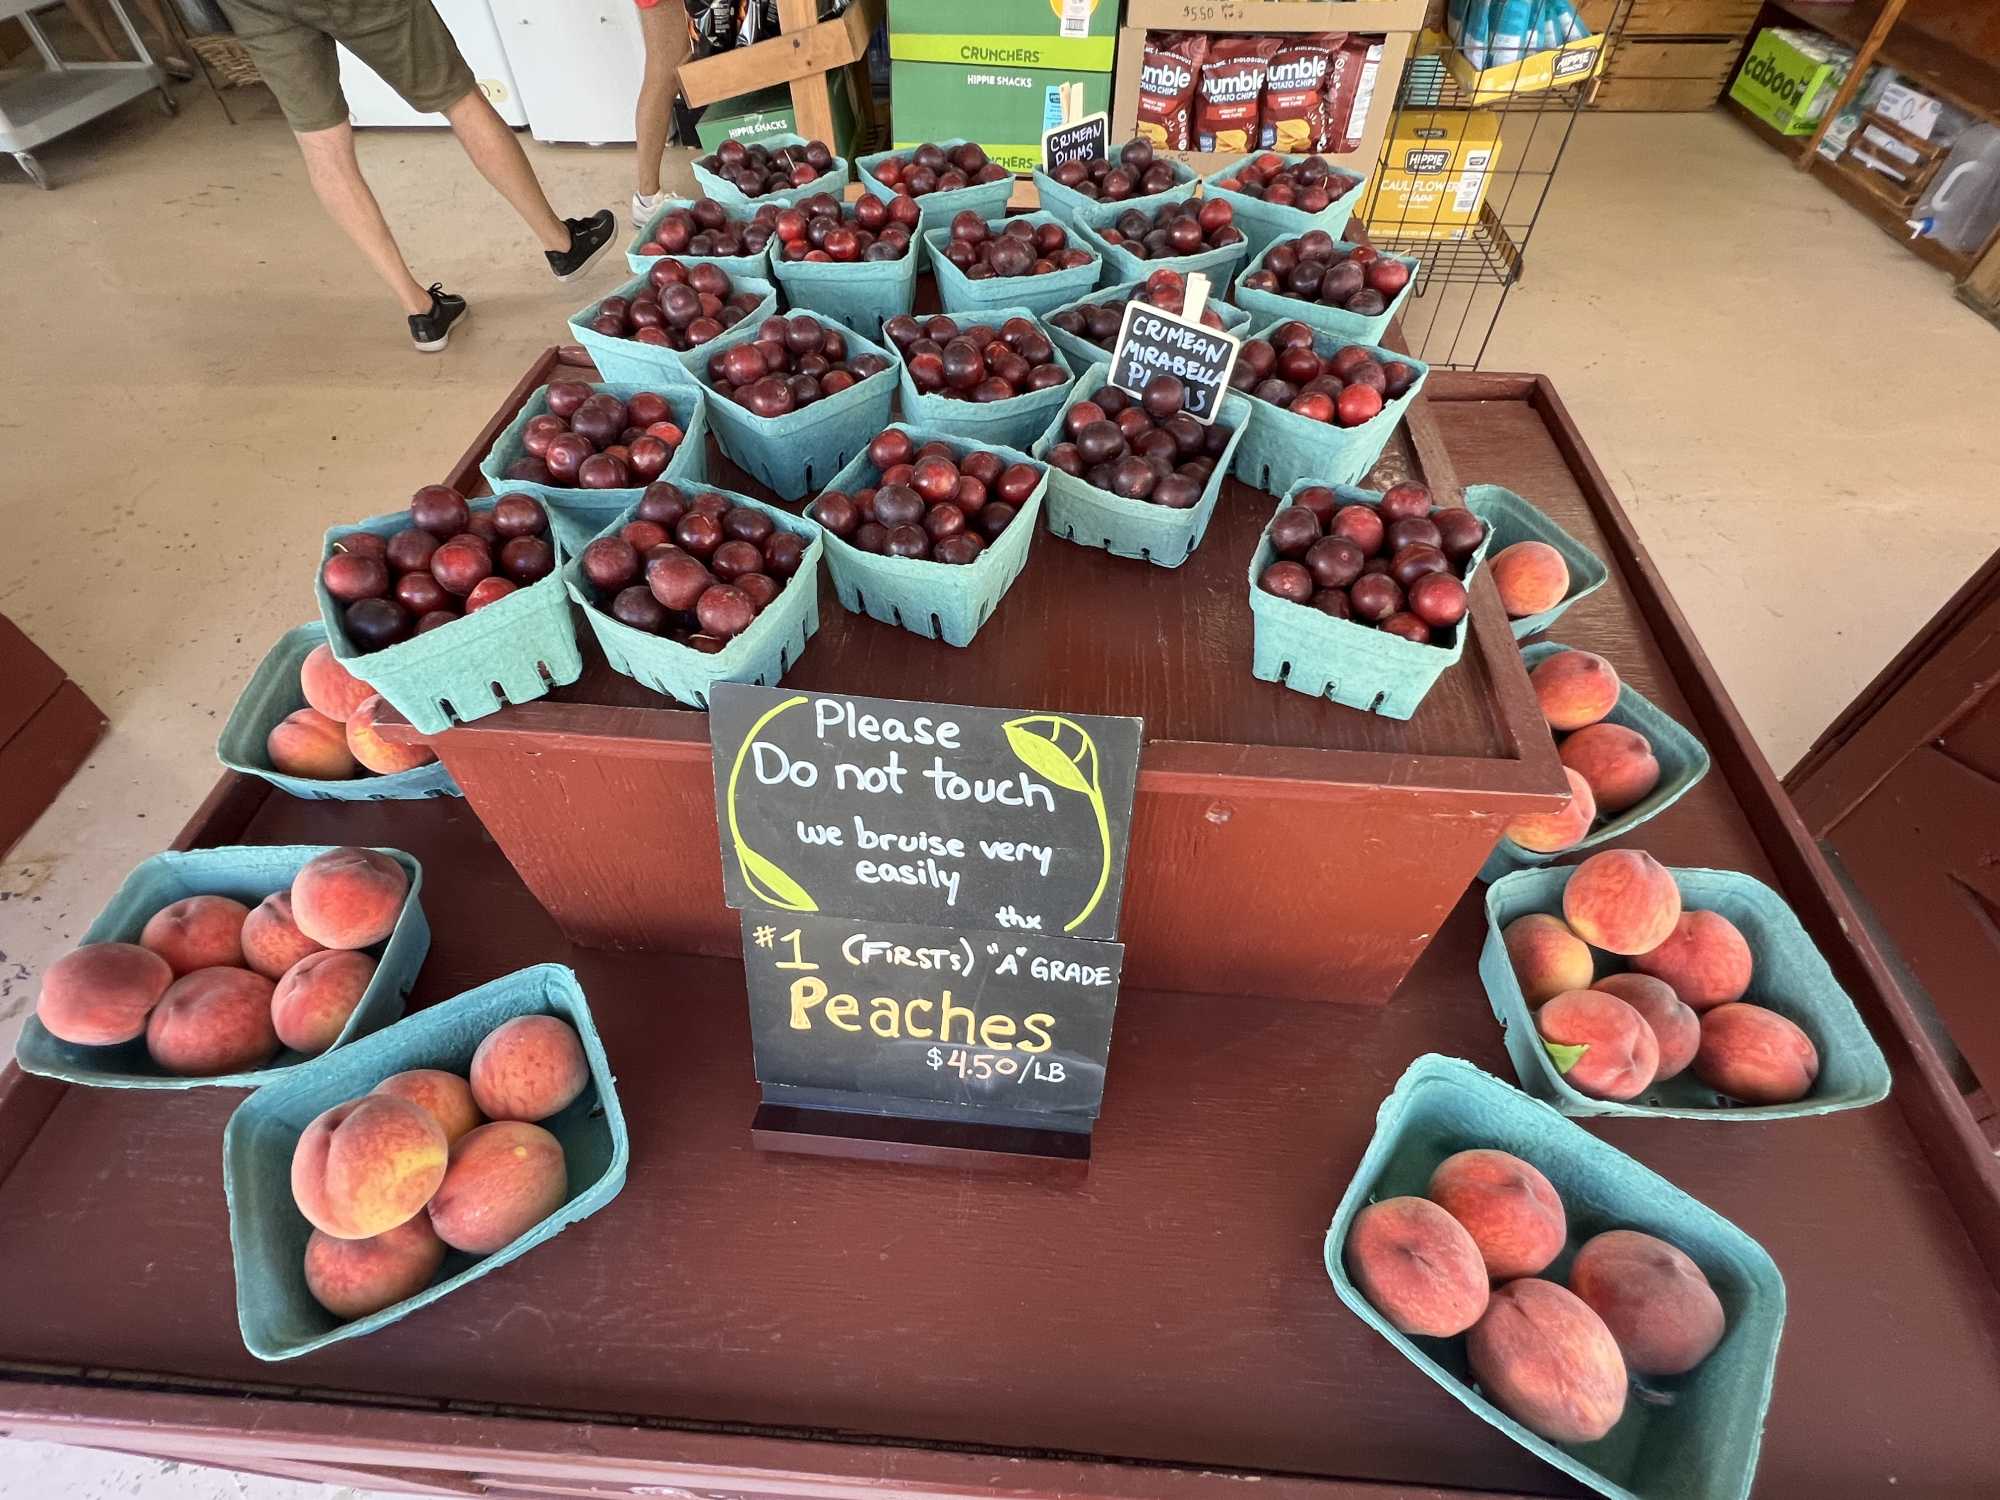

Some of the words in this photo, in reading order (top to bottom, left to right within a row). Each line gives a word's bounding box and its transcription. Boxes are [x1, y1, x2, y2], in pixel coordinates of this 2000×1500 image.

[960, 45, 1040, 63] CRUNCHERS
[1267, 55, 1326, 81] umble
[966, 74, 995, 86] HIPPIE
[996, 76, 1033, 88] SNACKS
[1140, 82, 1157, 92] OTATO
[1157, 85, 1178, 96] CHIPS
[1142, 64, 1191, 88] umble
[1268, 81, 1294, 90] POTATO
[1295, 78, 1317, 88] CHIPS
[1743, 51, 1796, 101] caboo
[1210, 93, 1234, 103] POTATO
[1235, 91, 1257, 101] CHIPS
[1050, 121, 1104, 151] CRIMEAN
[1408, 153, 1445, 167] HIPPIE
[1380, 179, 1459, 193] CAULFLOWER
[1132, 315, 1228, 364] CRIMEAN
[1121, 339, 1225, 387] MIRABELLA
[814, 698, 961, 749] Please
[751, 741, 819, 790] Do
[835, 750, 909, 794] not
[922, 755, 1057, 813] touch
[796, 820, 843, 847] we
[853, 815, 967, 859] bruise
[979, 838, 1053, 877] very
[855, 858, 960, 906] easily
[995, 906, 1042, 930] thx
[752, 924, 819, 971] #1
[1029, 959, 1113, 987] GRADE
[789, 975, 1057, 1054] Peaches
